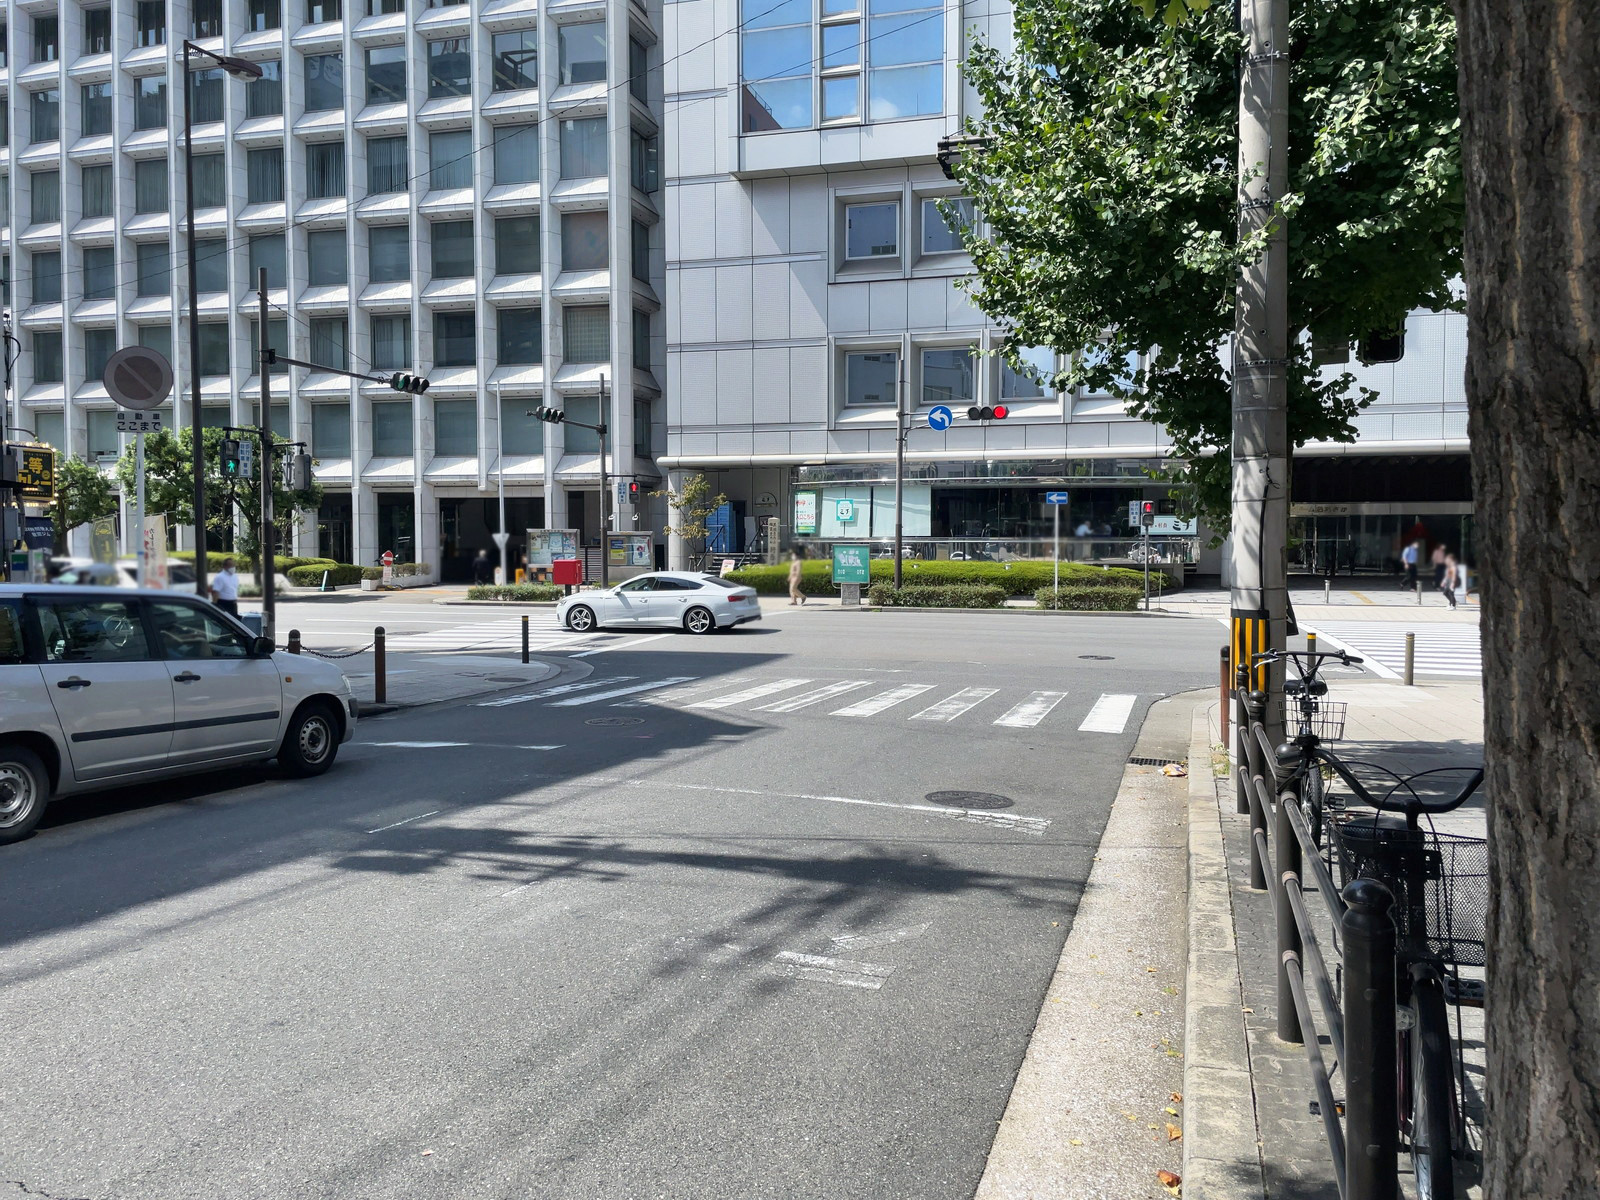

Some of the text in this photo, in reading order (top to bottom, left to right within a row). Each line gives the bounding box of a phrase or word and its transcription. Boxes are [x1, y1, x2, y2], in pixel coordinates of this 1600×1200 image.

[117, 412, 160, 420] 自動車
[117, 421, 161, 431] ここまで
